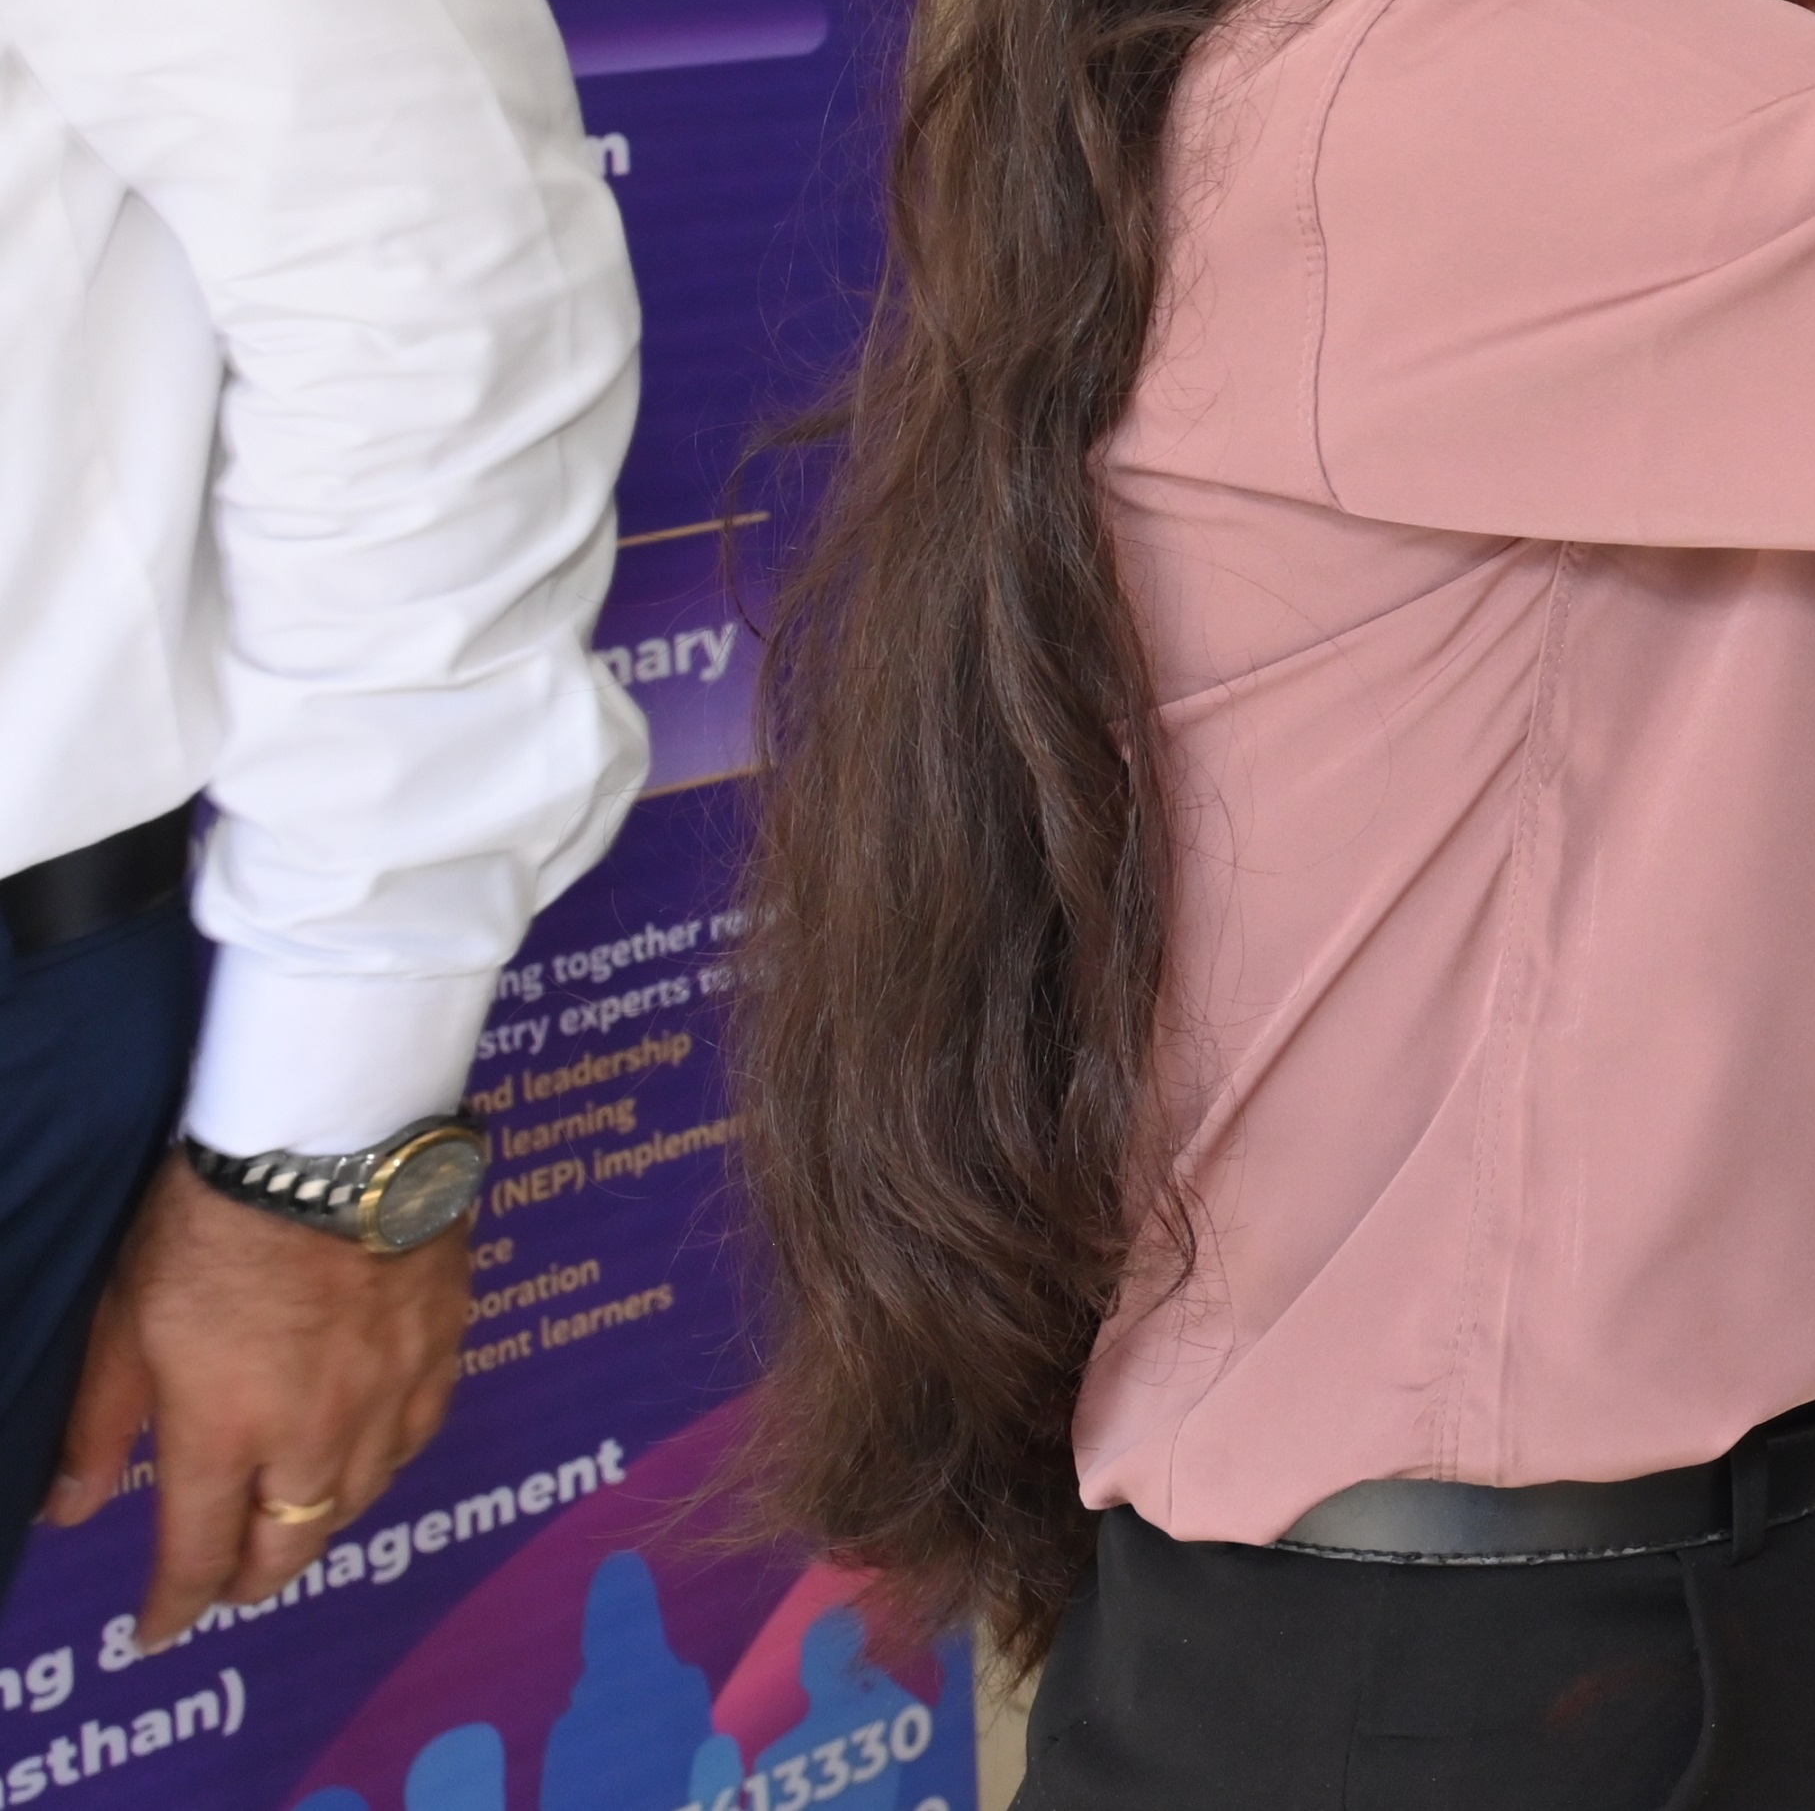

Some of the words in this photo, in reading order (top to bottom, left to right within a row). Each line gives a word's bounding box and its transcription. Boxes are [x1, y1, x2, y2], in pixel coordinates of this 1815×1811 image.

[552, 921, 702, 984] together
[560, 975, 691, 1034] experts
[470, 1075, 514, 1115] nd
[523, 1031, 693, 1103] leadership
[503, 1097, 638, 1161] learning
[491, 1156, 586, 1219] (NEP)
[540, 1283, 675, 1351] learners
[0, 1667, 247, 1811] sthan)
